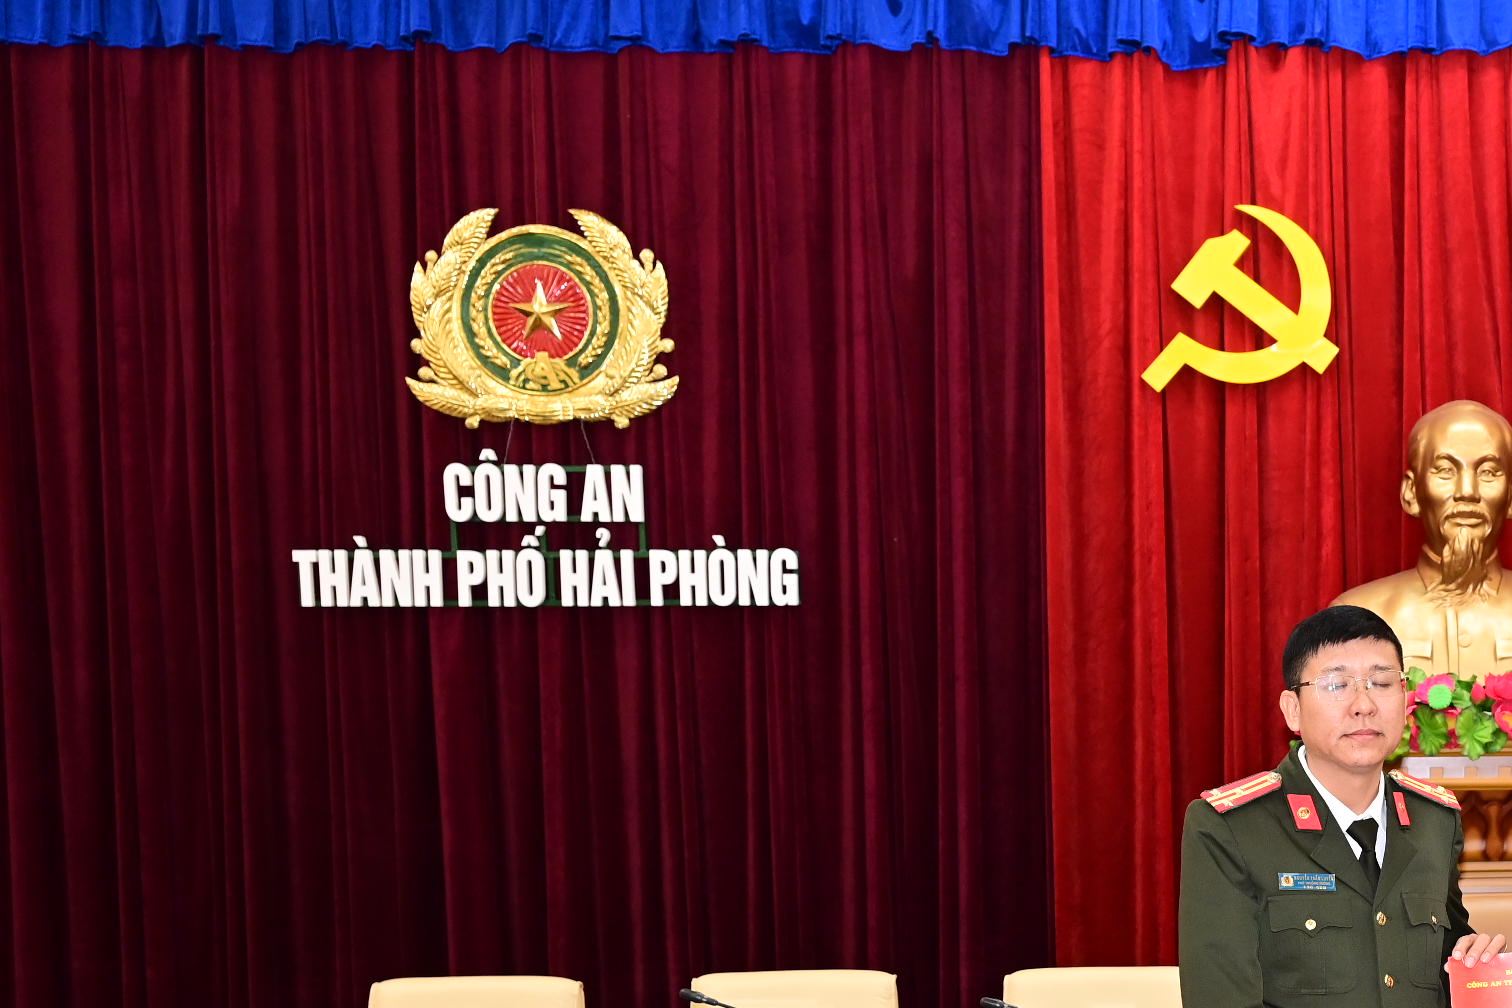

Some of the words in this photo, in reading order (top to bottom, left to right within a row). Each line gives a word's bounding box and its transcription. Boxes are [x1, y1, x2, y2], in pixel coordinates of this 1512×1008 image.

[443, 449, 568, 523] CÔNG
[580, 464, 645, 523] AN
[292, 536, 444, 607] THÀNH
[456, 526, 549, 607] PHỐ
[559, 529, 637, 607] HẢI
[649, 535, 800, 607] PHÒNG
[1466, 980, 1489, 989] CÔNG
[1491, 980, 1502, 988] AN
